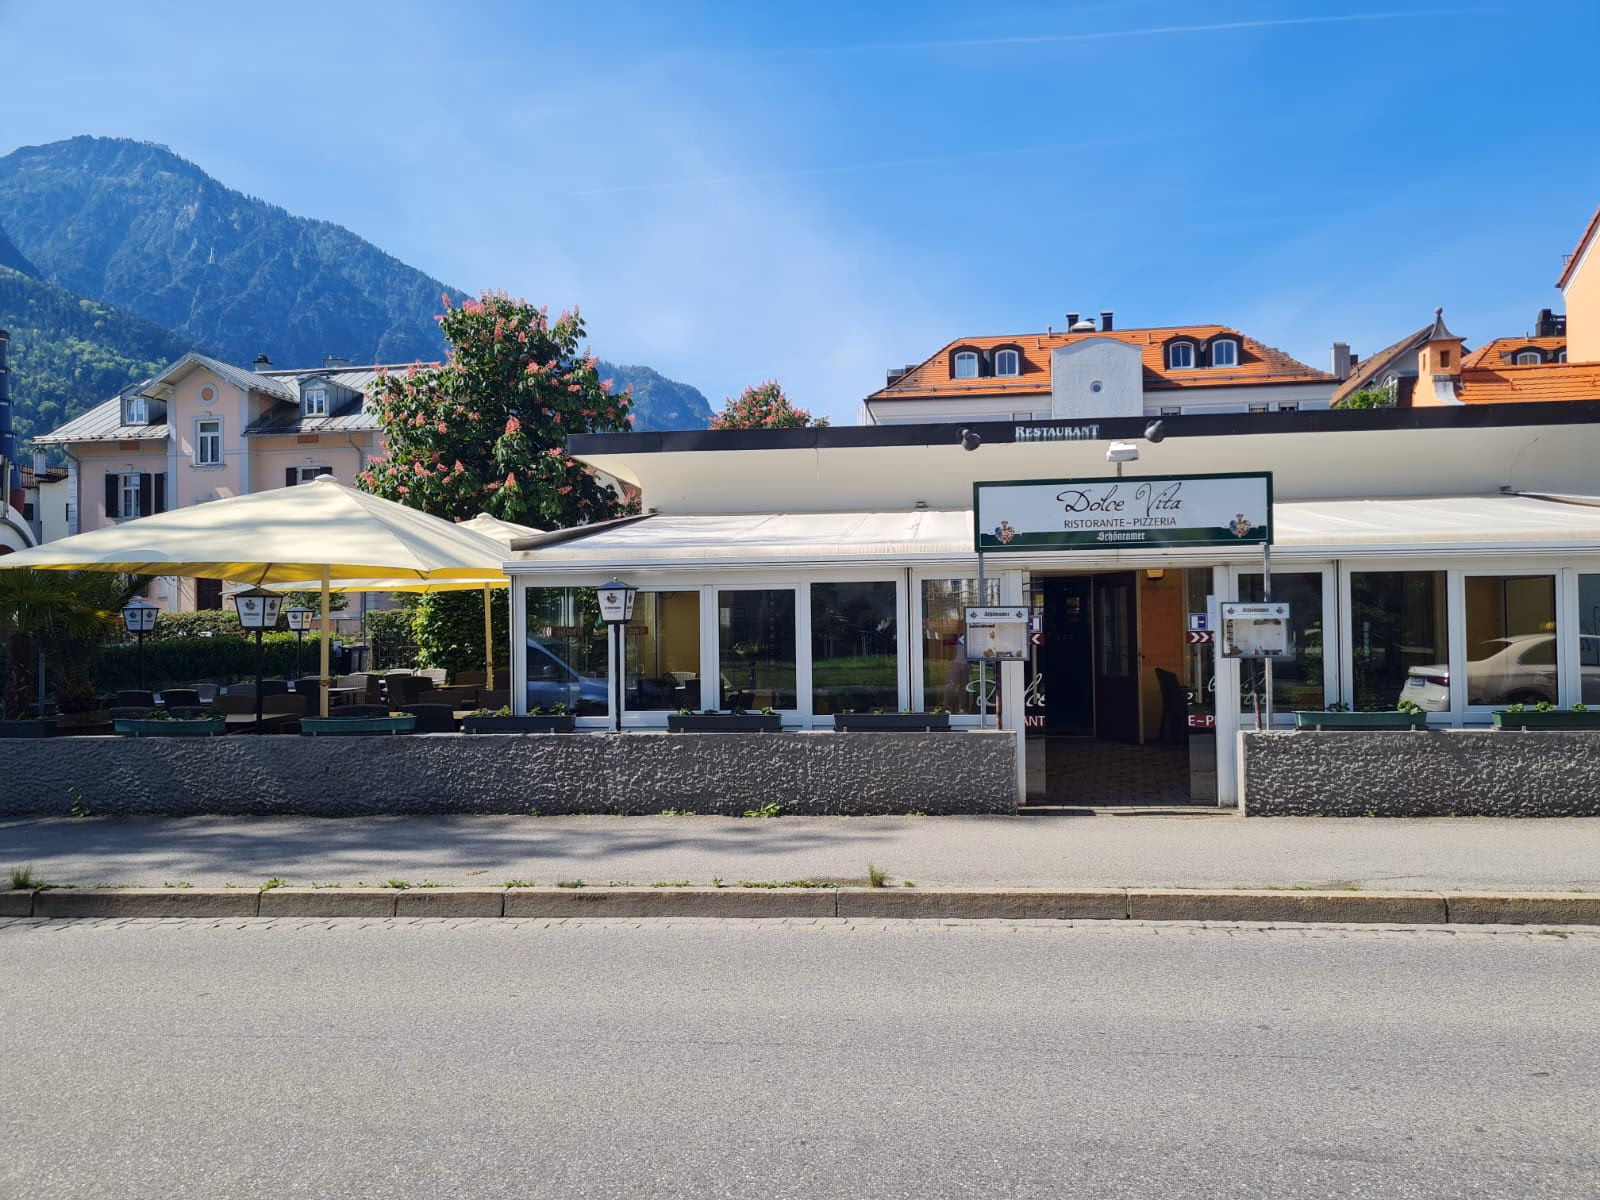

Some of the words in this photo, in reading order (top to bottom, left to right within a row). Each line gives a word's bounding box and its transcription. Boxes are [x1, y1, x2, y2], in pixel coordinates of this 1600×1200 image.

[1015, 424, 1100, 437] RESTAURANT
[1056, 484, 1125, 513] Dolce
[1135, 481, 1183, 518] Vita
